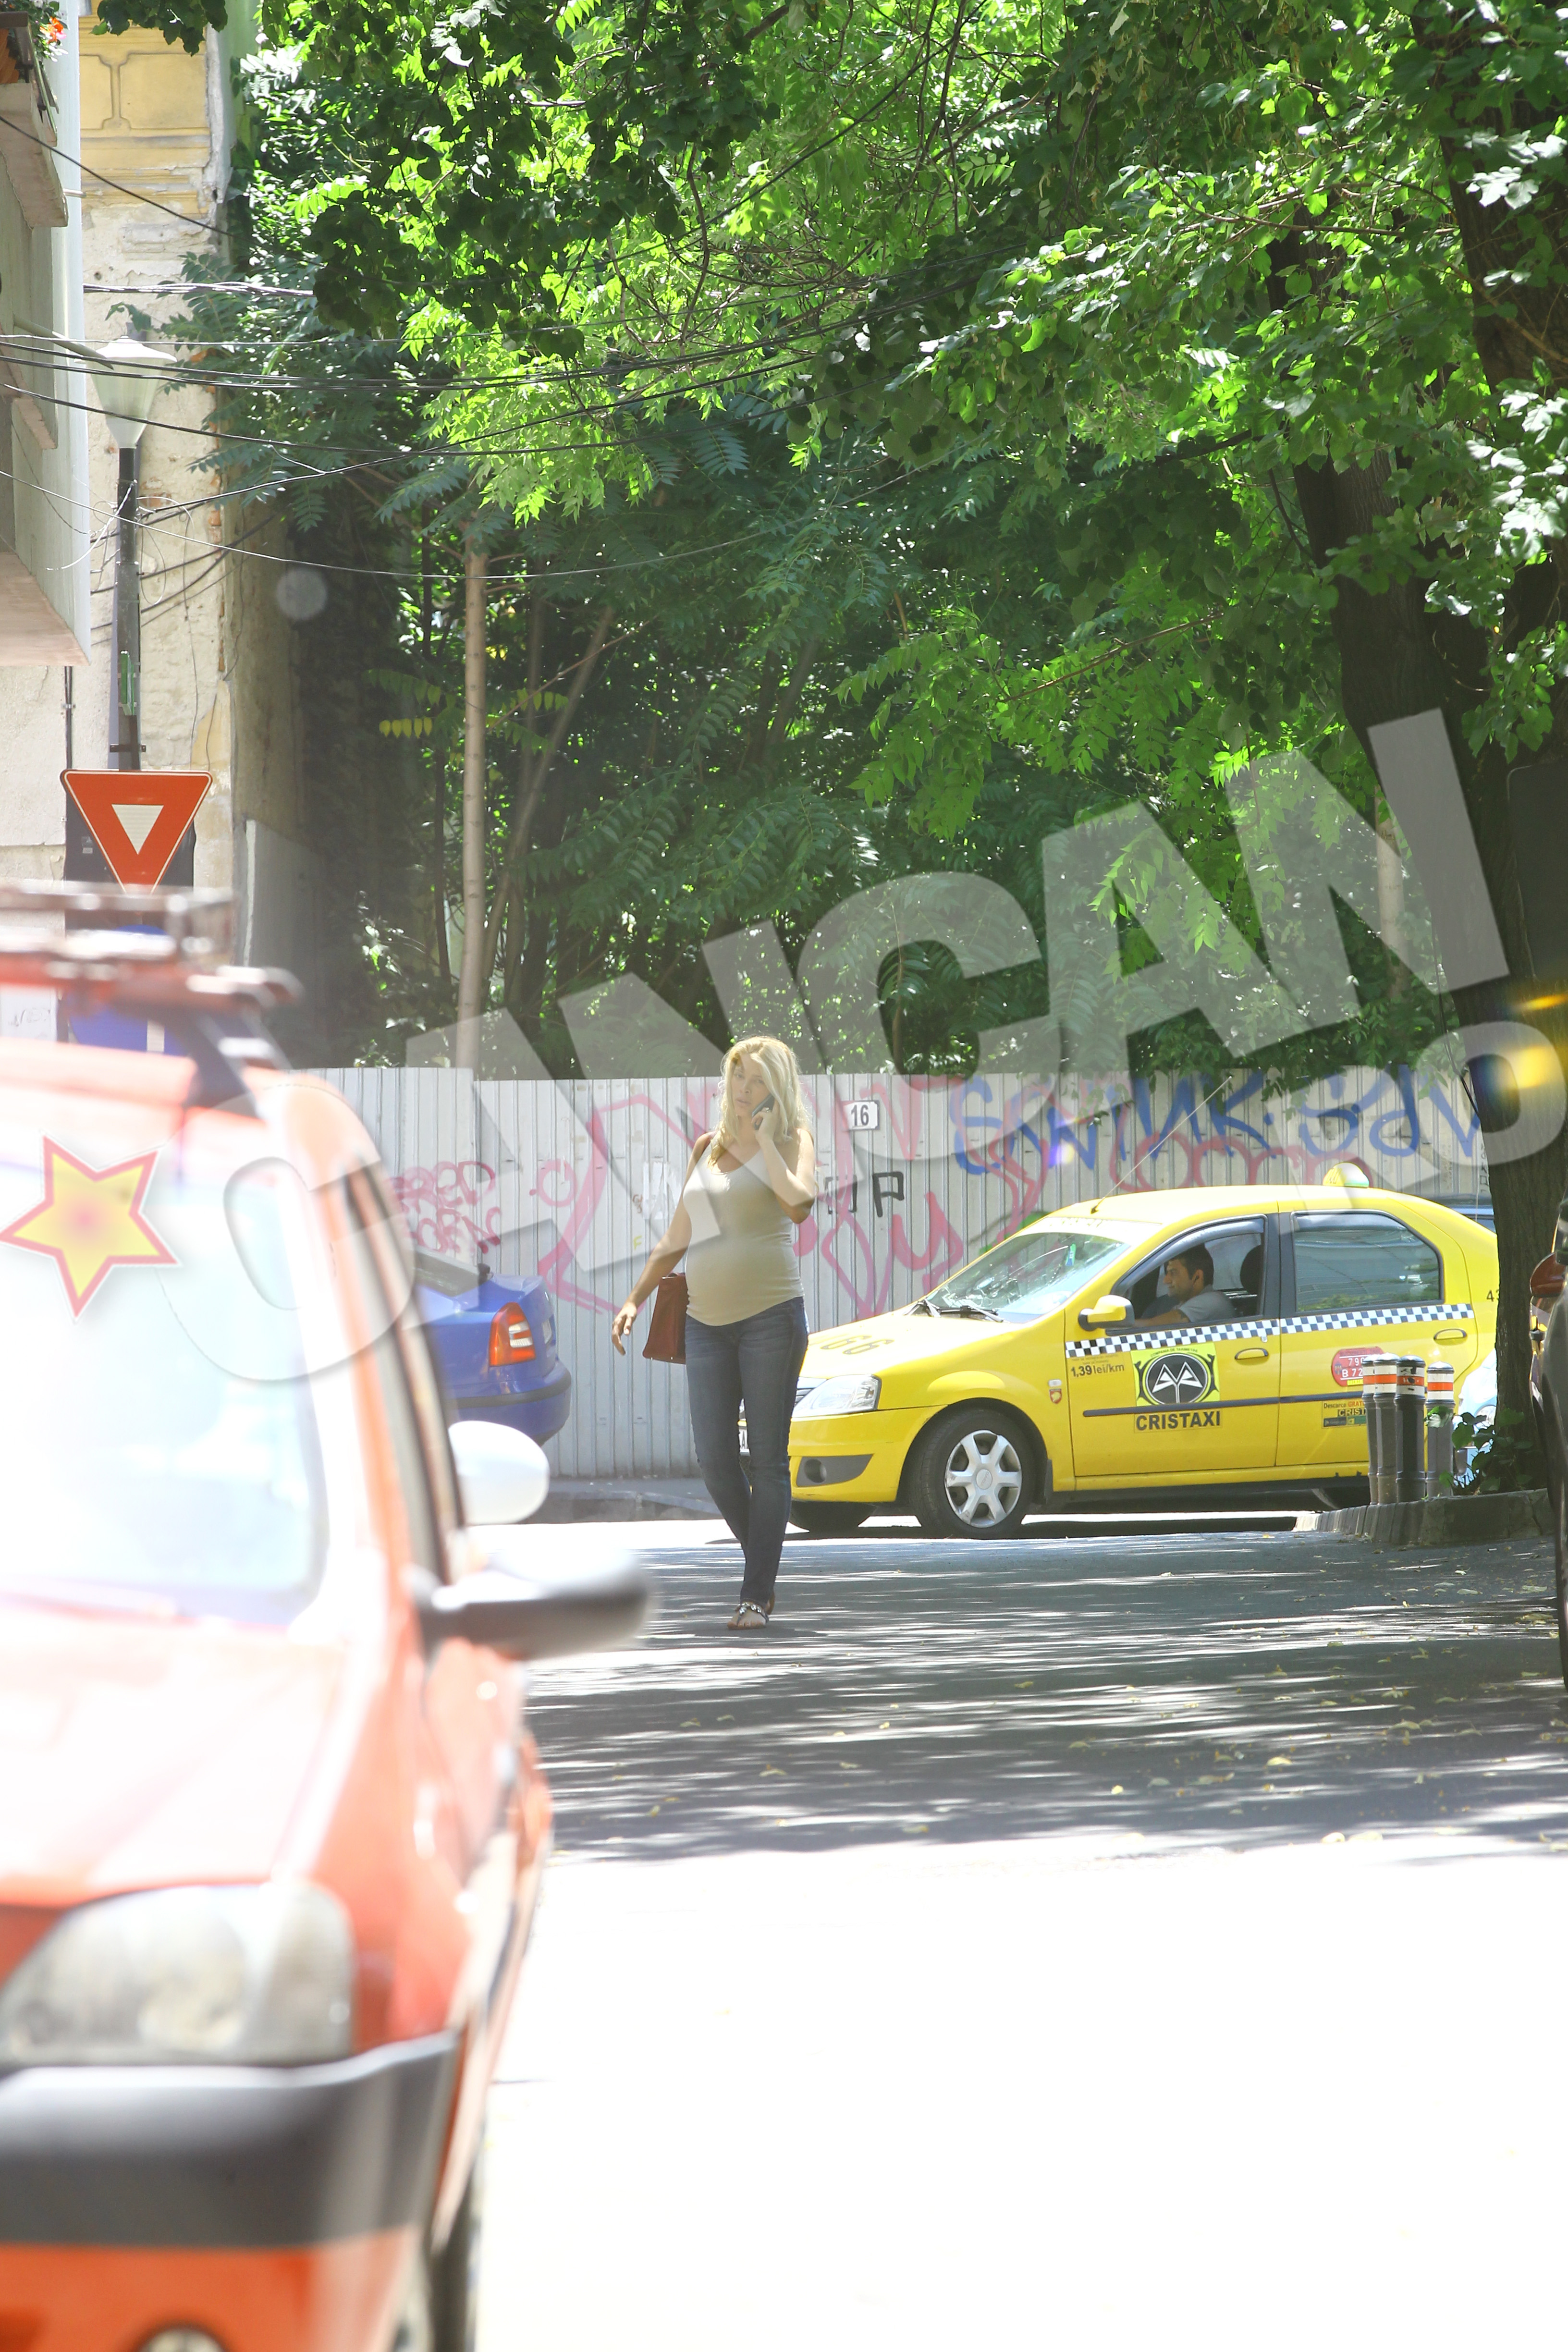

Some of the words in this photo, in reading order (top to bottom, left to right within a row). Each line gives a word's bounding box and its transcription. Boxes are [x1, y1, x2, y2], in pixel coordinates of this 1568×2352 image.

[851, 1104, 870, 1127] 16
[1071, 1365, 1092, 1378] 1,39
[1093, 1363, 1125, 1374] lei/km
[1342, 1369, 1348, 1378] B
[1136, 1410, 1221, 1431] CRISTAXI
